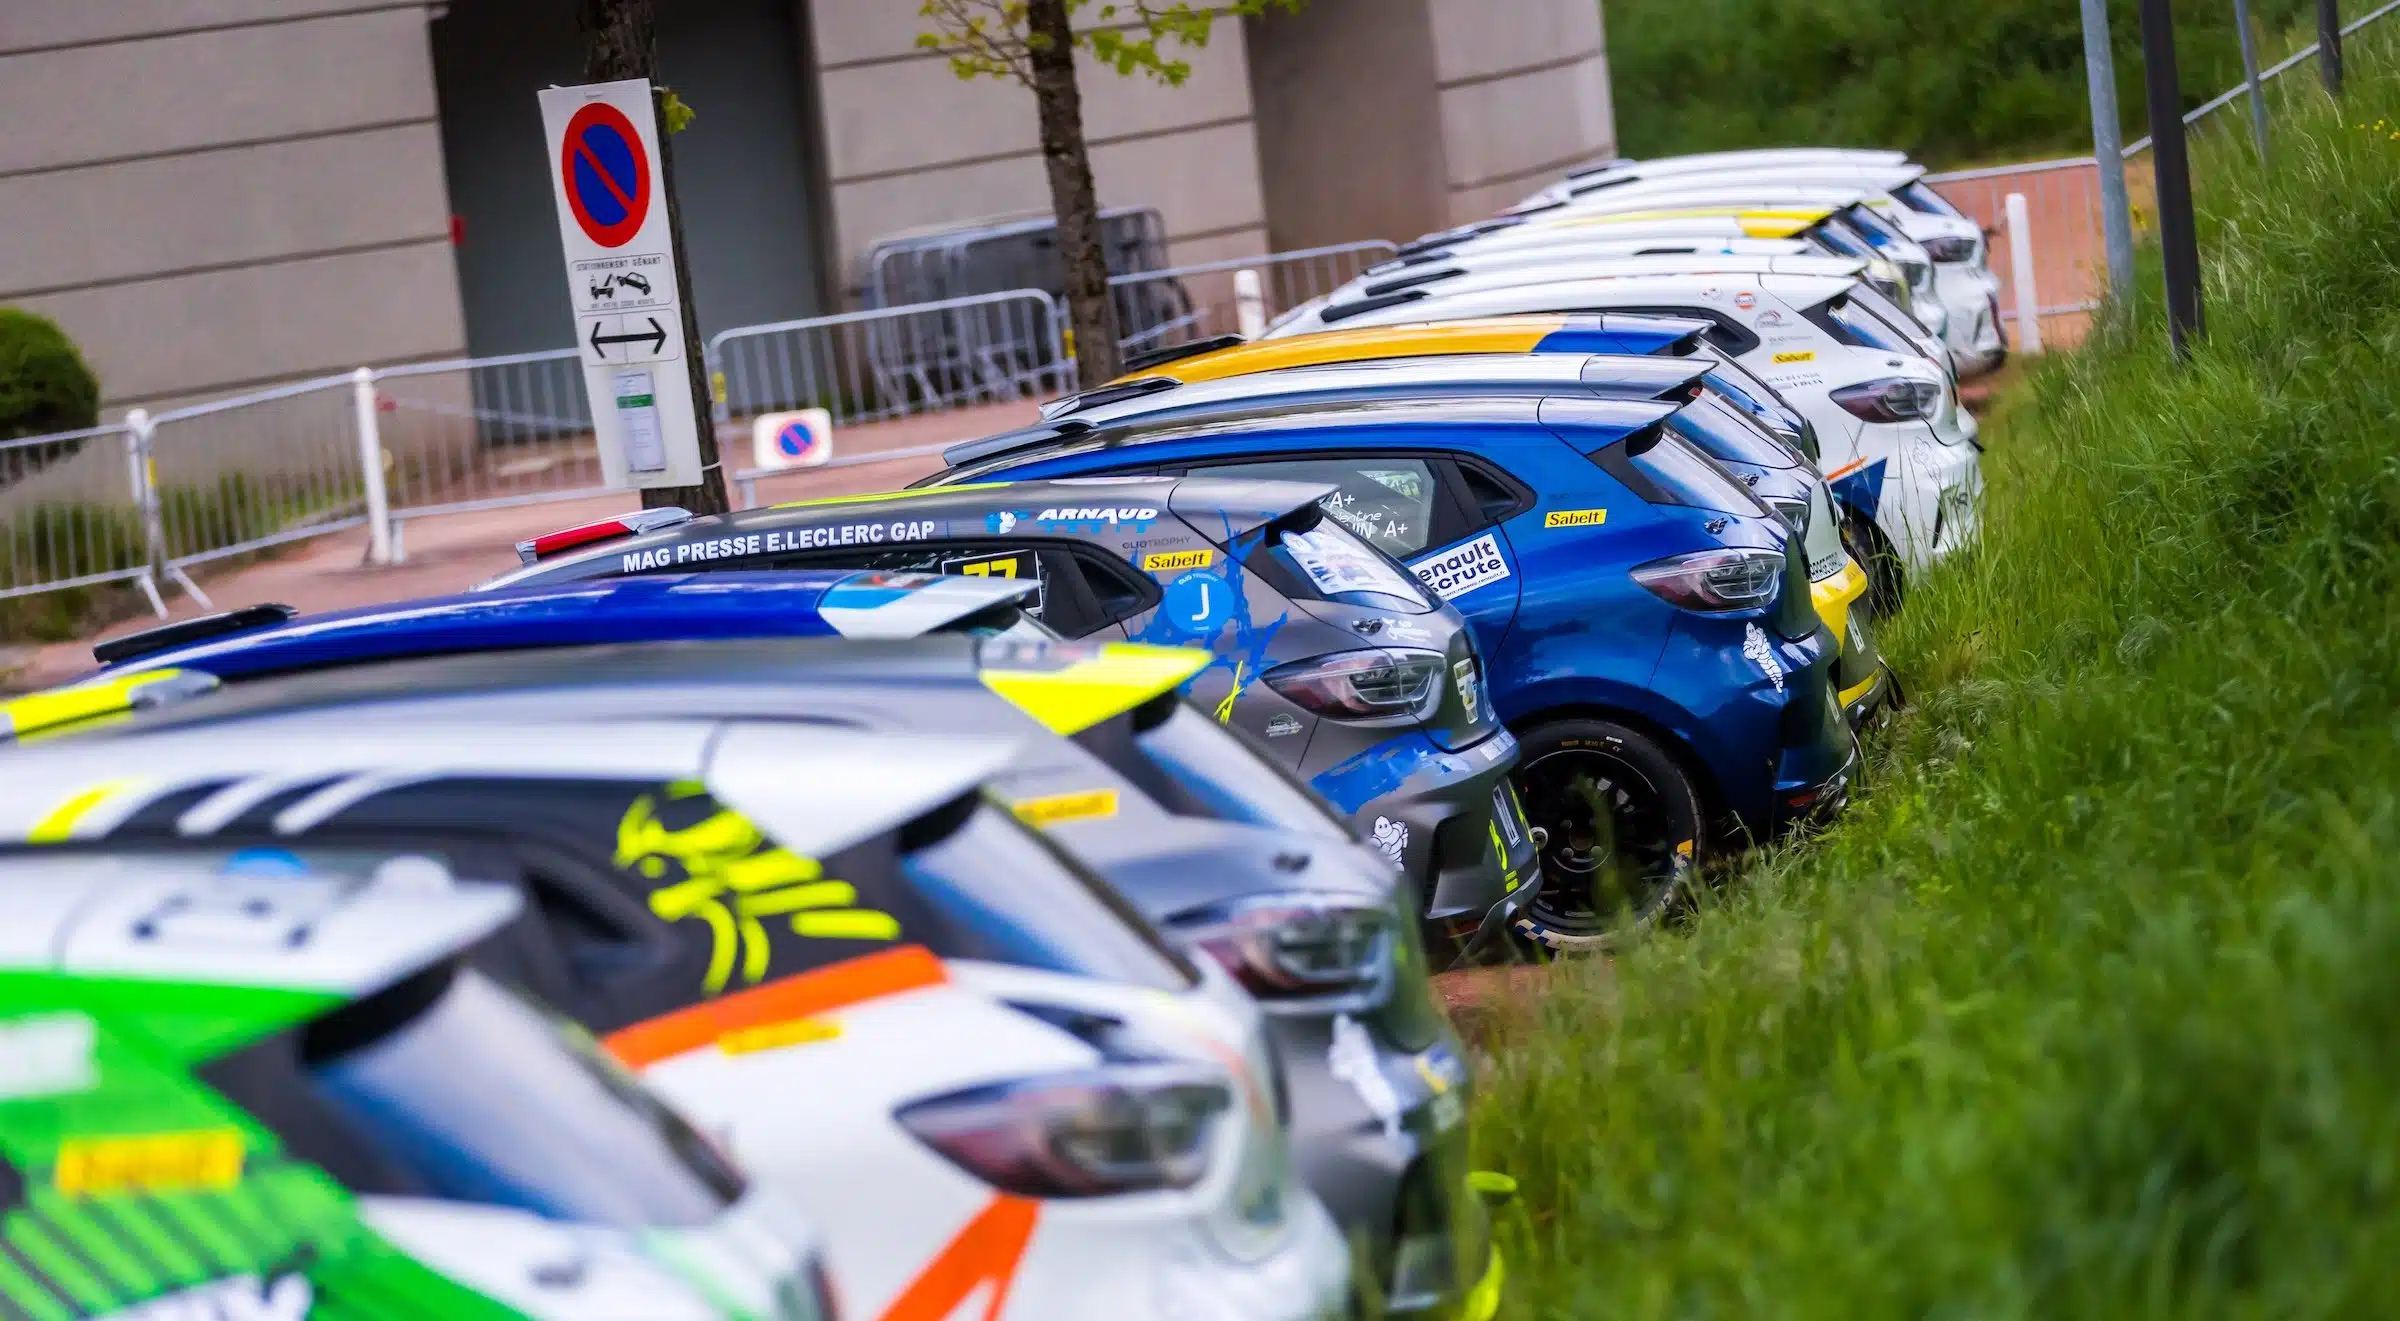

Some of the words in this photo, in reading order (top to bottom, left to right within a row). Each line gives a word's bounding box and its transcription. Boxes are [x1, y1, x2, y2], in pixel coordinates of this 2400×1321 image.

[1328, 491, 1355, 509] A+
[1036, 508, 1158, 524] ARNAUD
[1549, 512, 1600, 526] Sabelt
[1383, 520, 1409, 538] A+
[623, 547, 671, 573] MAG
[677, 535, 760, 564] PRESSE
[767, 523, 884, 552] E.LECLERC
[890, 520, 936, 541] GAP
[1149, 552, 1205, 569] Sabelt
[1191, 583, 1210, 621] J
